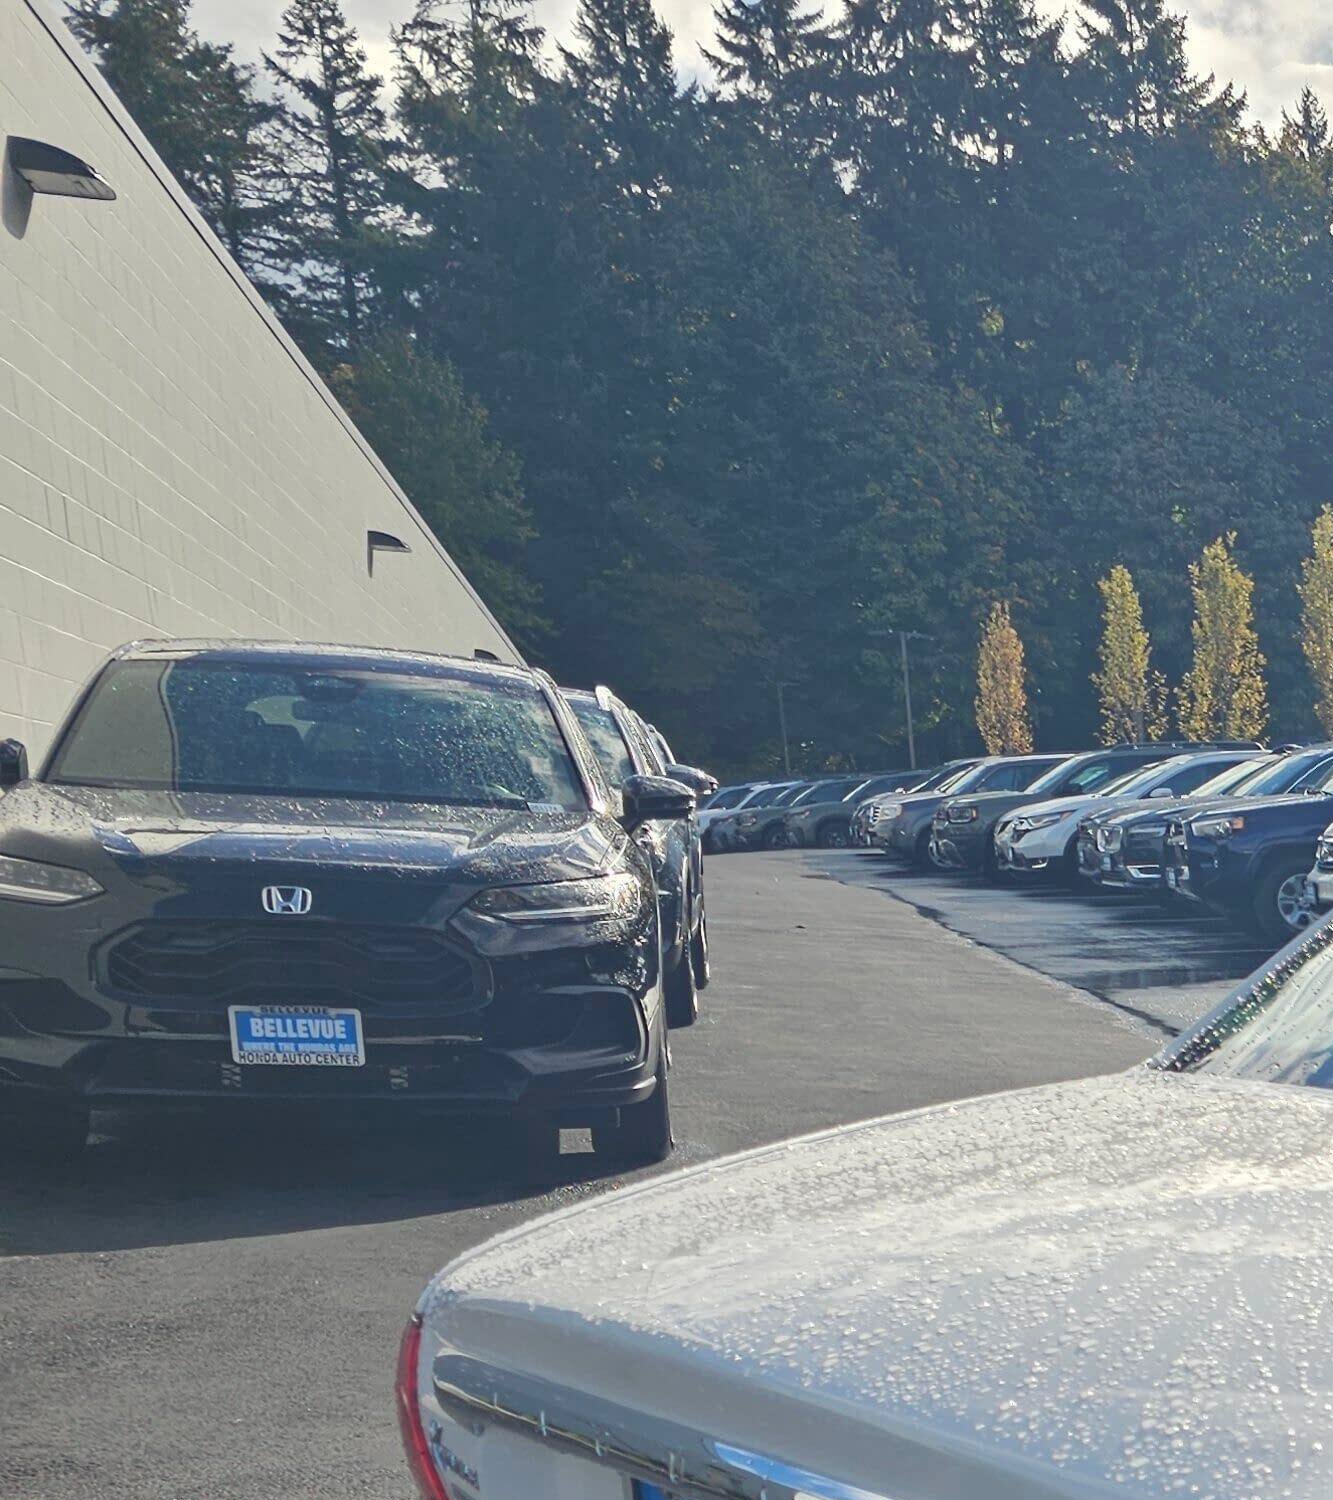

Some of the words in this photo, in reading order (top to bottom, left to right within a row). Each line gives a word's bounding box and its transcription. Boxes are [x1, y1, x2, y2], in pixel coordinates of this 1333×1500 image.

[250, 1018, 347, 1039] BELLEVUE
[239, 1052, 278, 1064] HONDA
[282, 1053, 312, 1064] AUTO
[315, 1054, 360, 1067] CENTER
